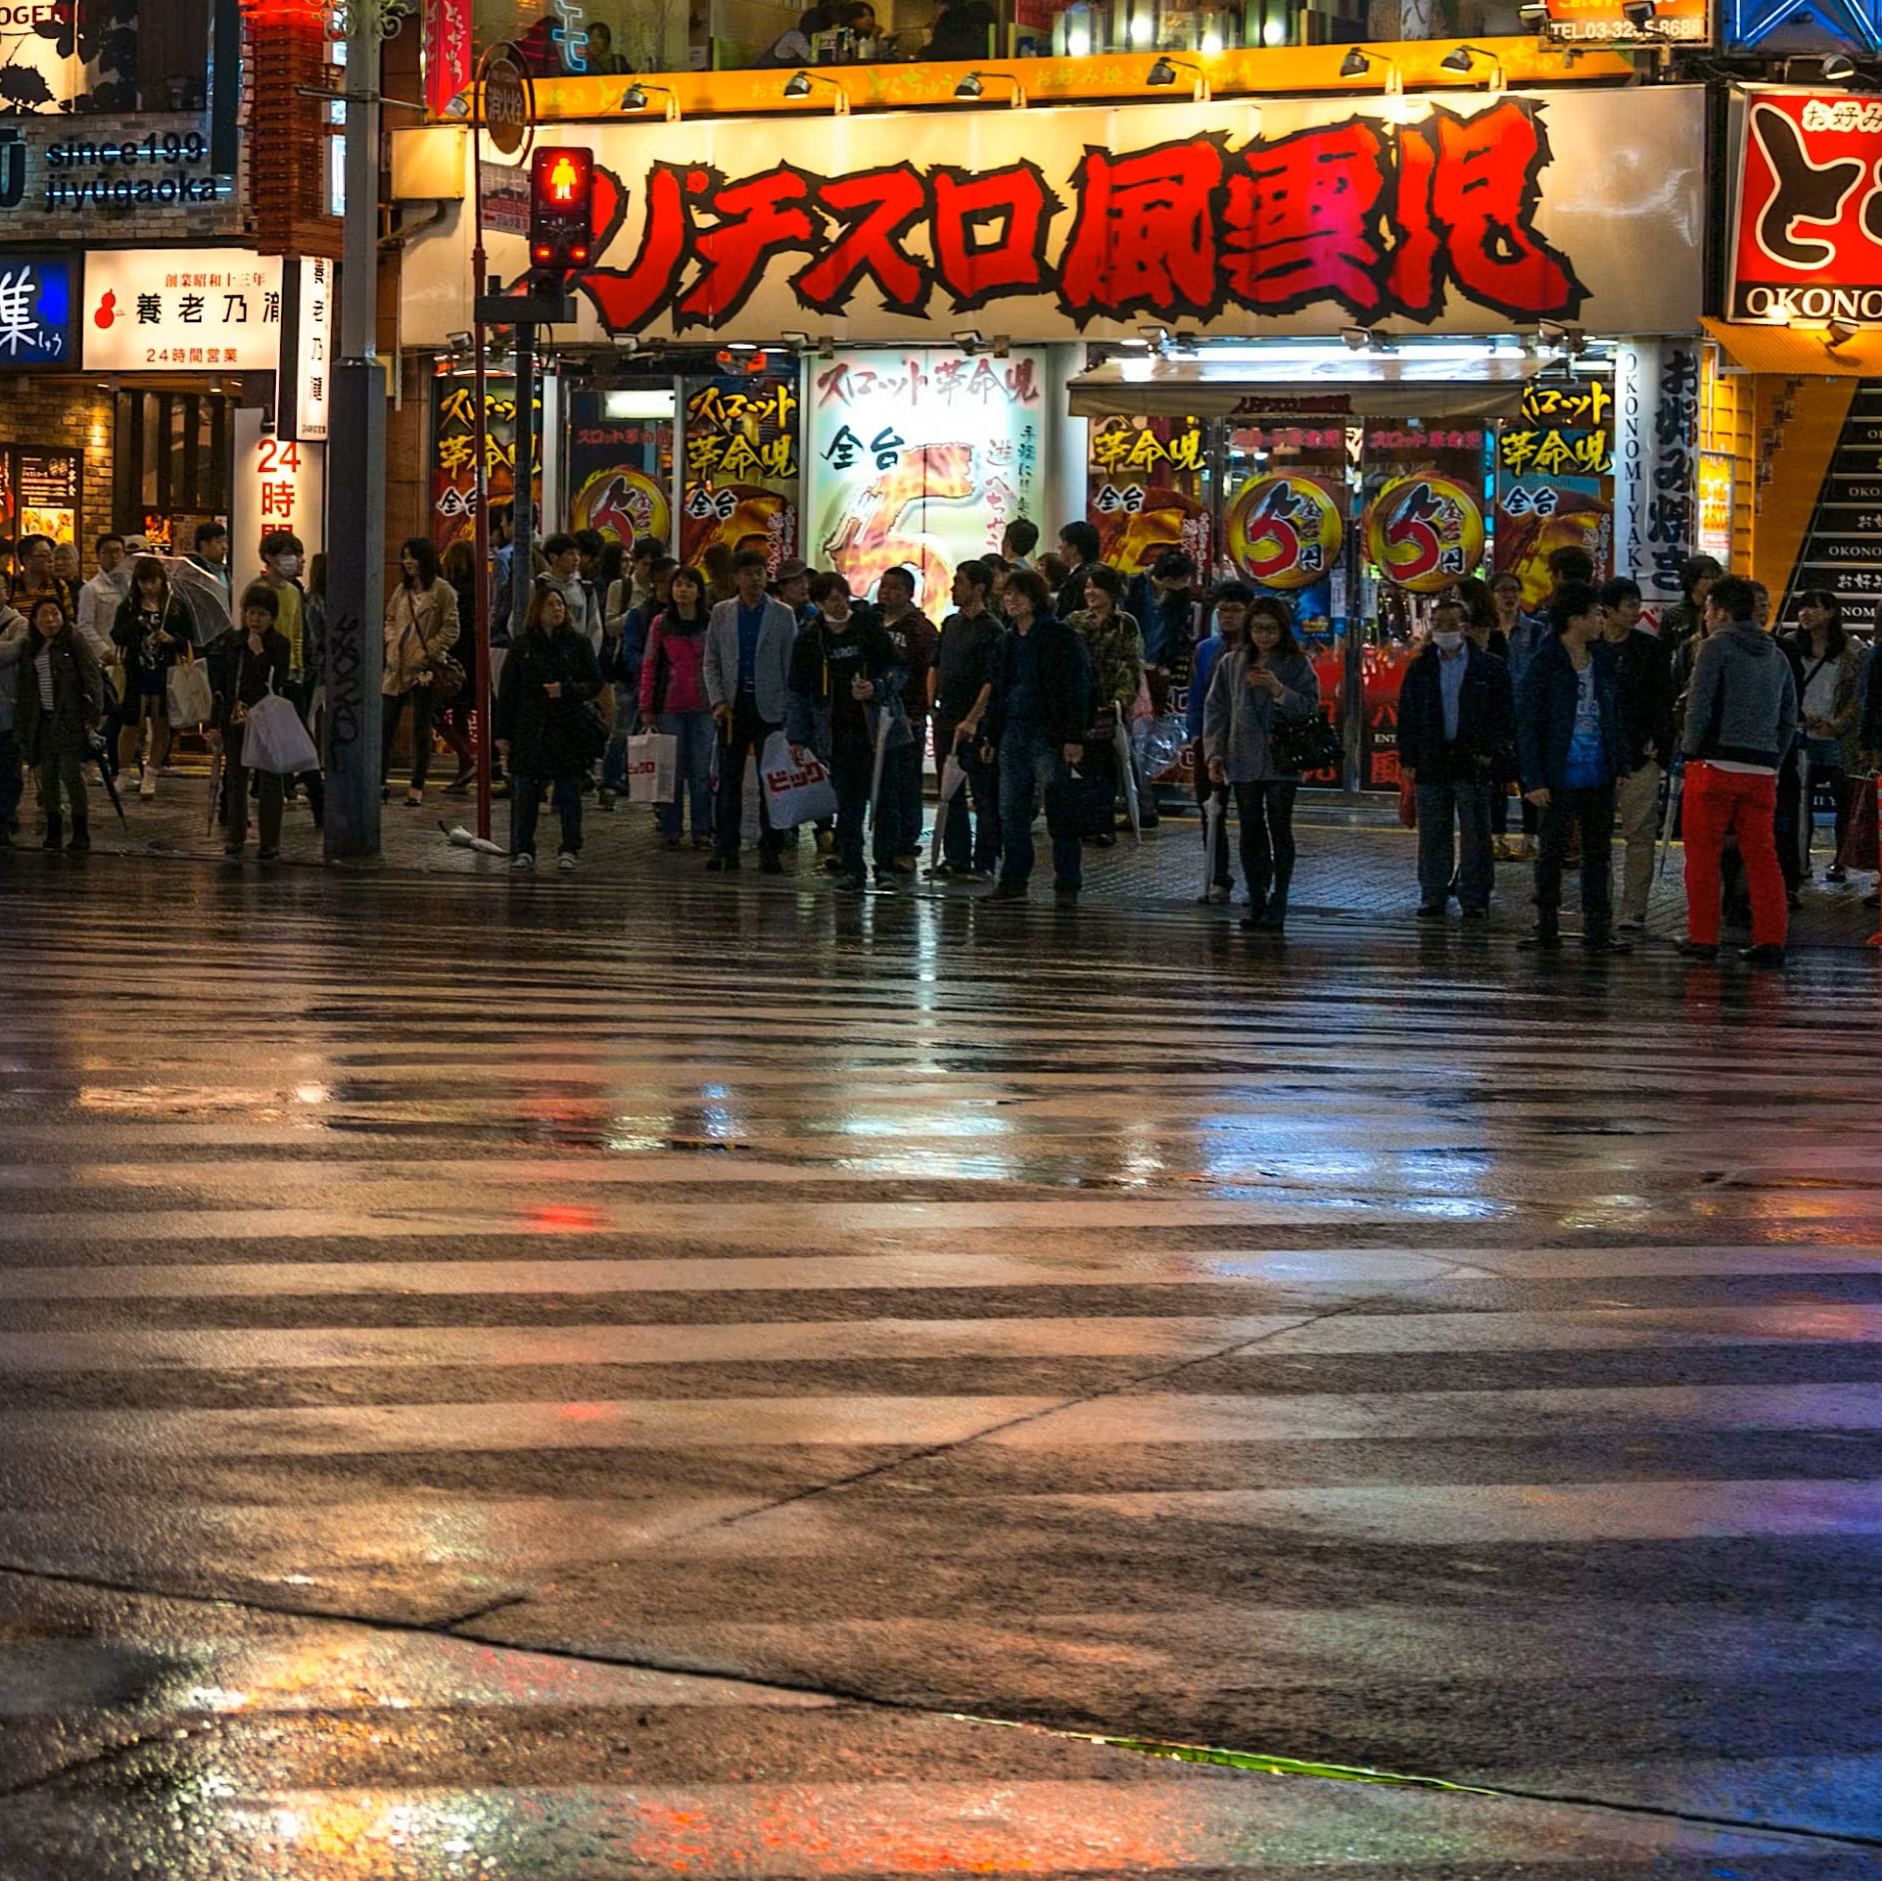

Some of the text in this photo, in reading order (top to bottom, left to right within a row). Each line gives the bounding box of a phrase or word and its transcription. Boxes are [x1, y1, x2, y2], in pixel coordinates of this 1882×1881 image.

[164, 272, 266, 288] 創業昭和十三年
[145, 347, 238, 364] 24時間営業
[689, 383, 796, 432] スロット
[686, 434, 798, 481] 革命児
[820, 424, 902, 470] 全台
[1093, 427, 1206, 473] 革命児
[1501, 427, 1615, 475] 革命児
[1647, 348, 1700, 593] お好み焼き
[685, 487, 738, 520] 全台
[1502, 485, 1559, 518] 全台
[1440, 545, 1466, 572] 円
